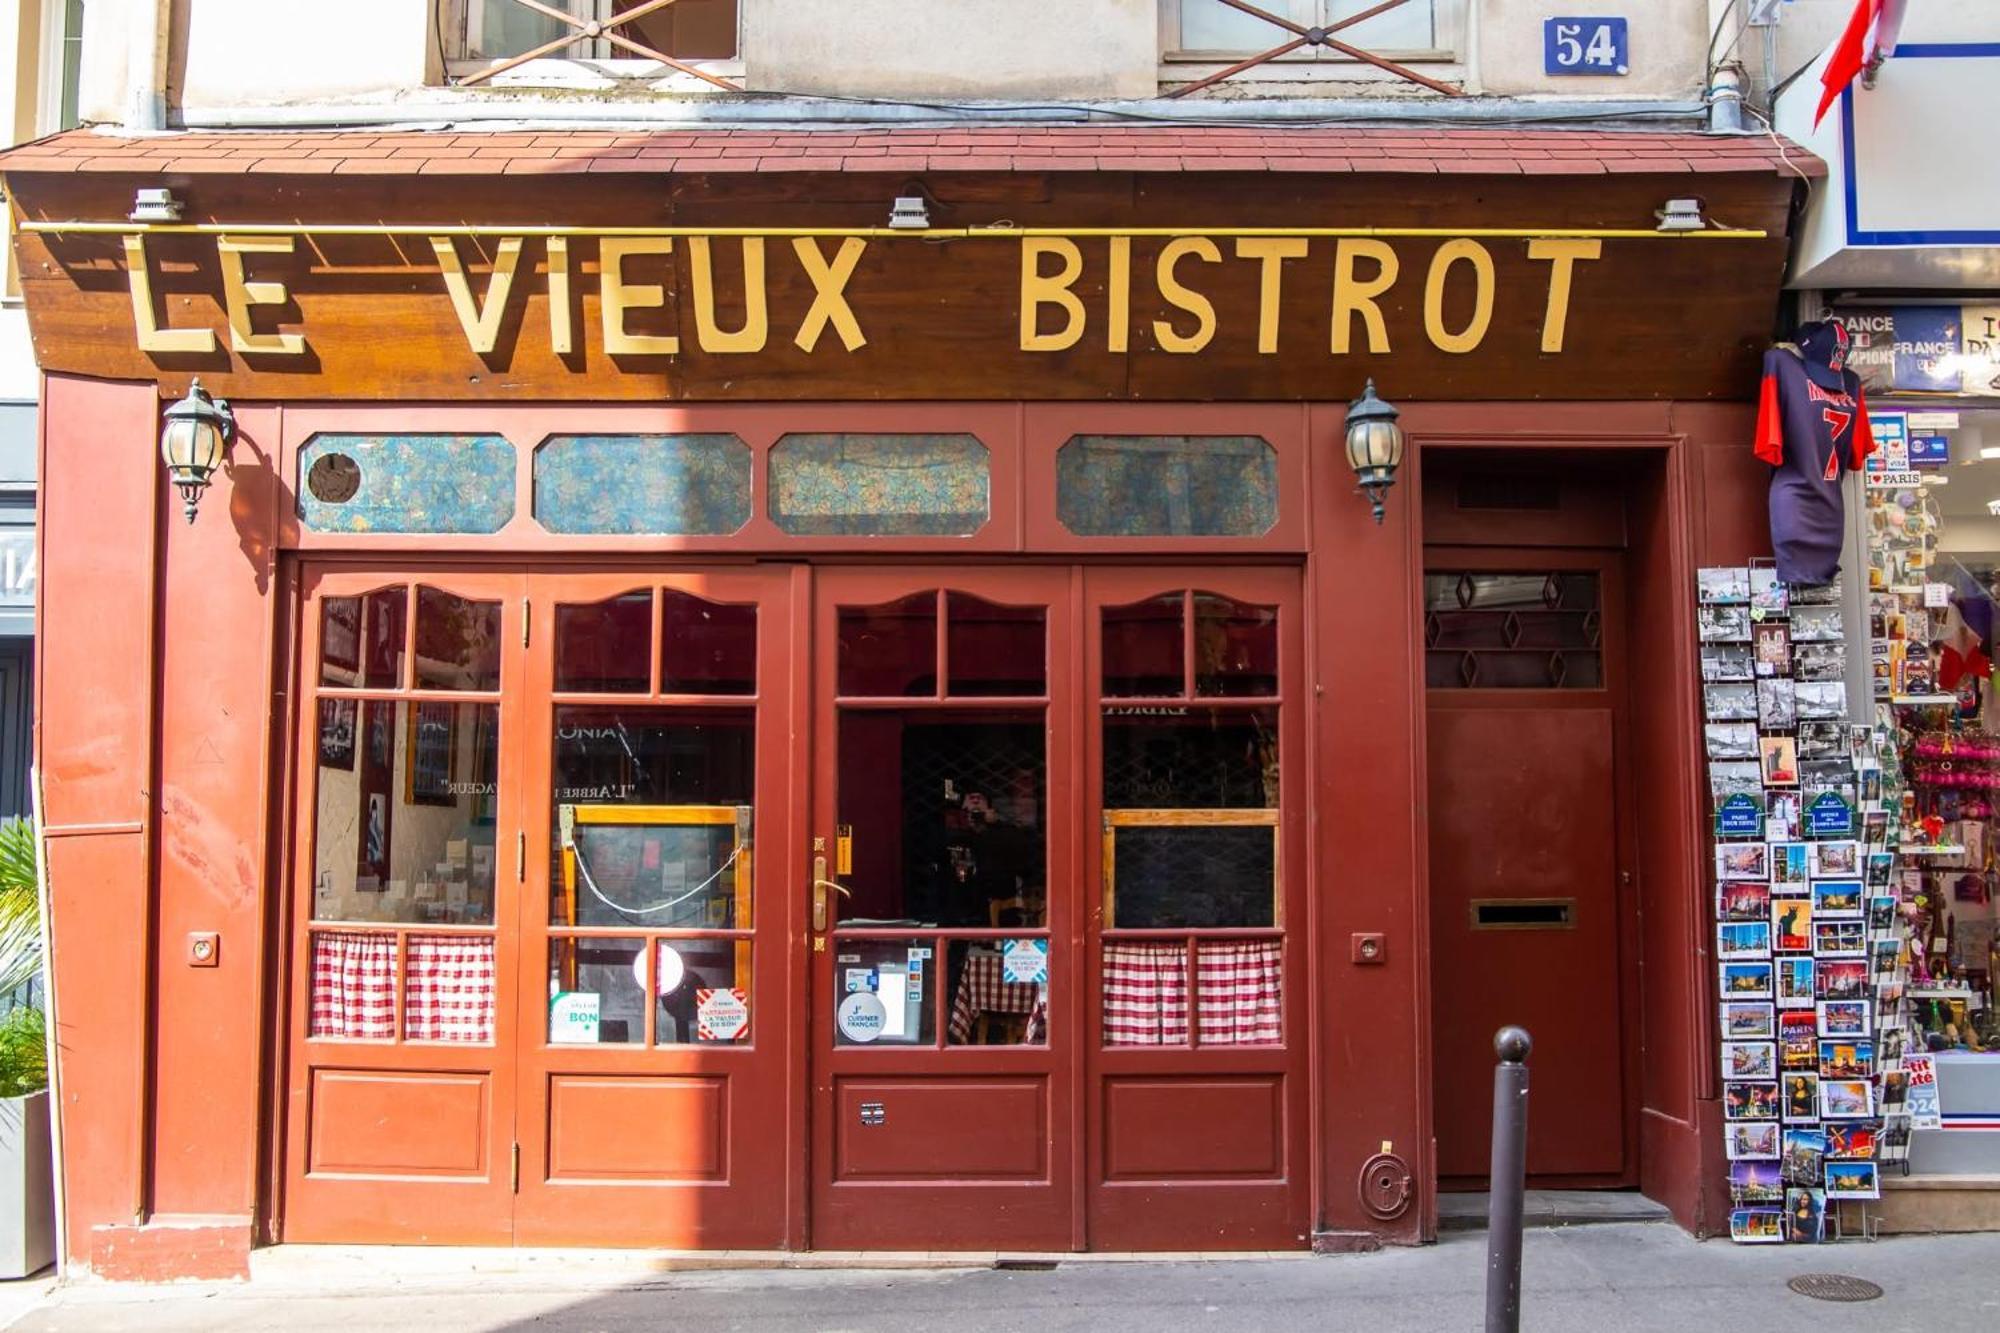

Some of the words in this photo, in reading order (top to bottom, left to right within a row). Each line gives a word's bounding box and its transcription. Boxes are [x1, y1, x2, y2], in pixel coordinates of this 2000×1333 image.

[1556, 24, 1617, 66] 54
[124, 235, 305, 354] LE
[429, 236, 867, 355] VIEUX
[1020, 236, 1602, 354] BISTROT
[1895, 341, 1955, 355] FRANCE
[1823, 407, 1852, 481] 7
[1883, 474, 1920, 484] PARIS
[569, 1012, 598, 1022] BON
[1782, 1025, 1814, 1035] PARIS
